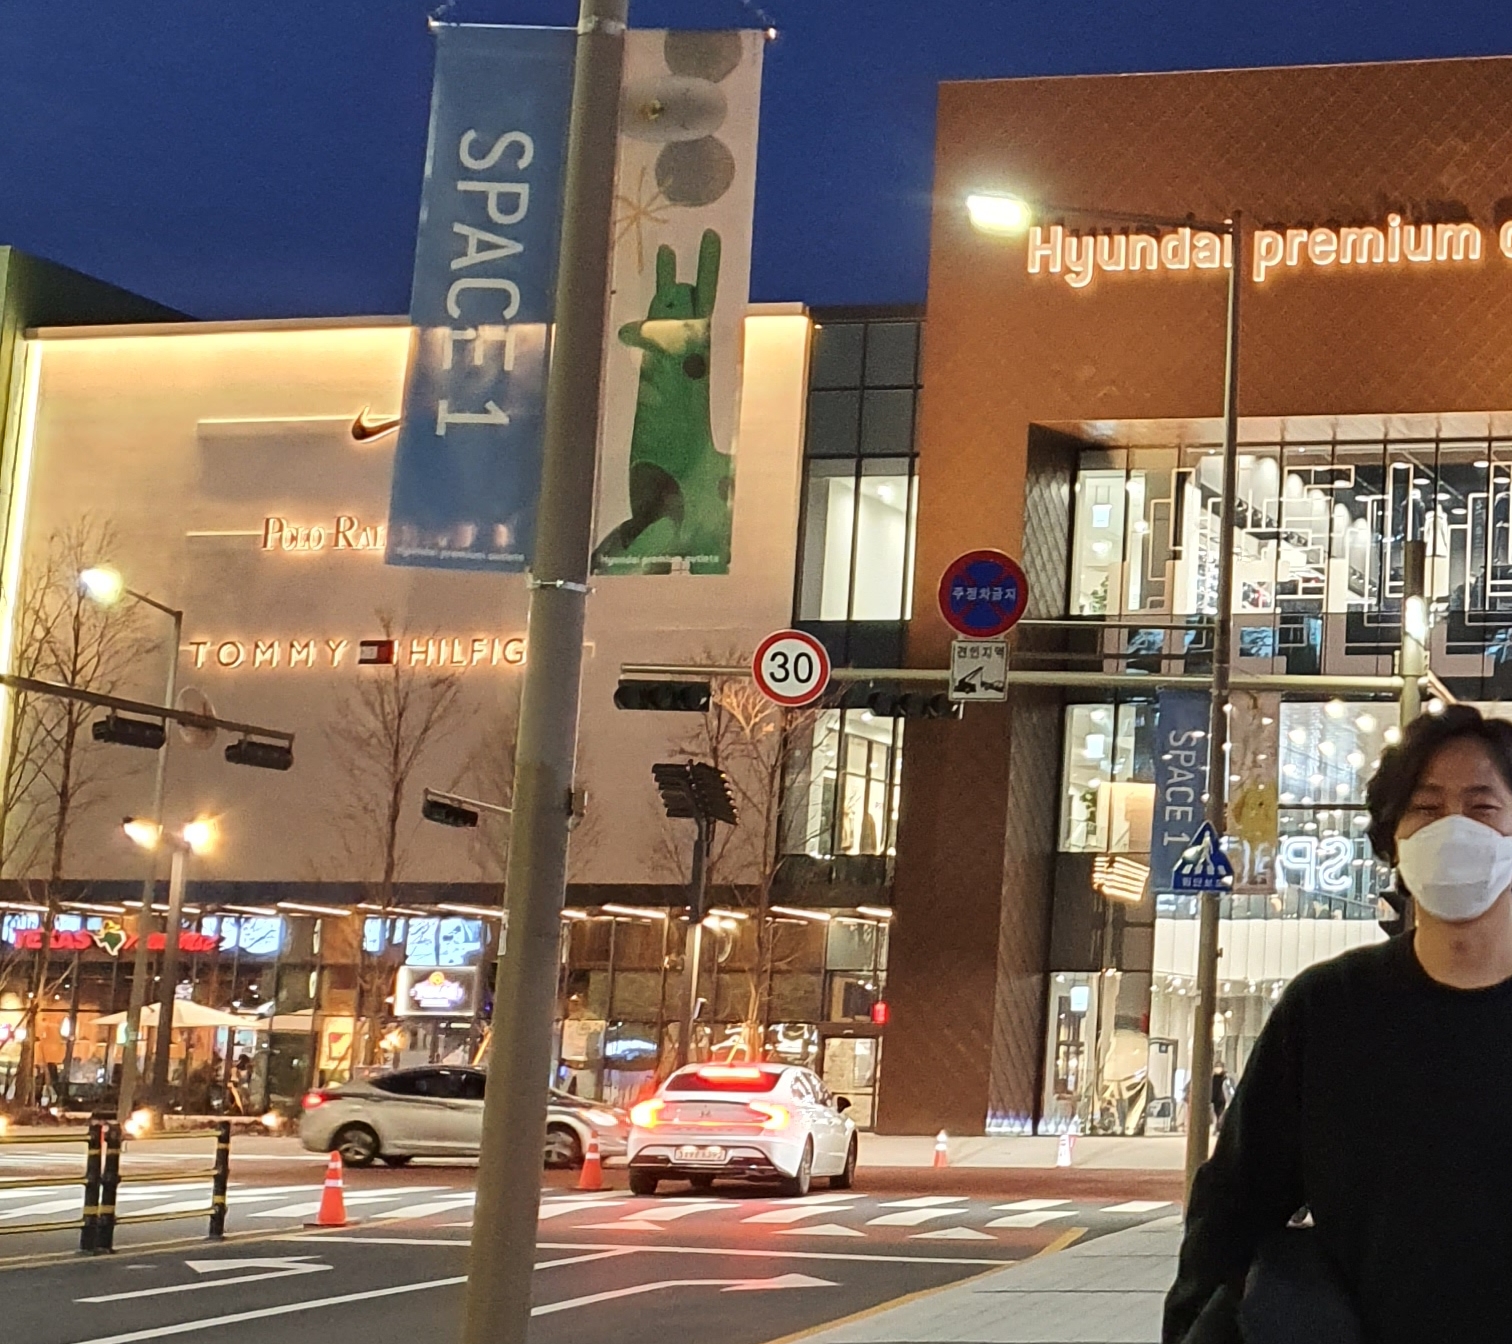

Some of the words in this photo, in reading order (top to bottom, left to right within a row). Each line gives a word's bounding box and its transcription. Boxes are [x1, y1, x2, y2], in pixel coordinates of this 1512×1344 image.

[441, 128, 534, 371] SPACE
[1253, 213, 1481, 282] premium
[434, 399, 510, 437] 1
[333, 515, 387, 549] RAL
[951, 586, 1017, 601] 주정차금지
[189, 640, 348, 668] TOMMY
[409, 638, 528, 667] HILFIG
[769, 651, 813, 684] 30
[957, 645, 1005, 658] 견인지역
[1163, 730, 1196, 823] SPACE
[1163, 832, 1190, 846] 1
